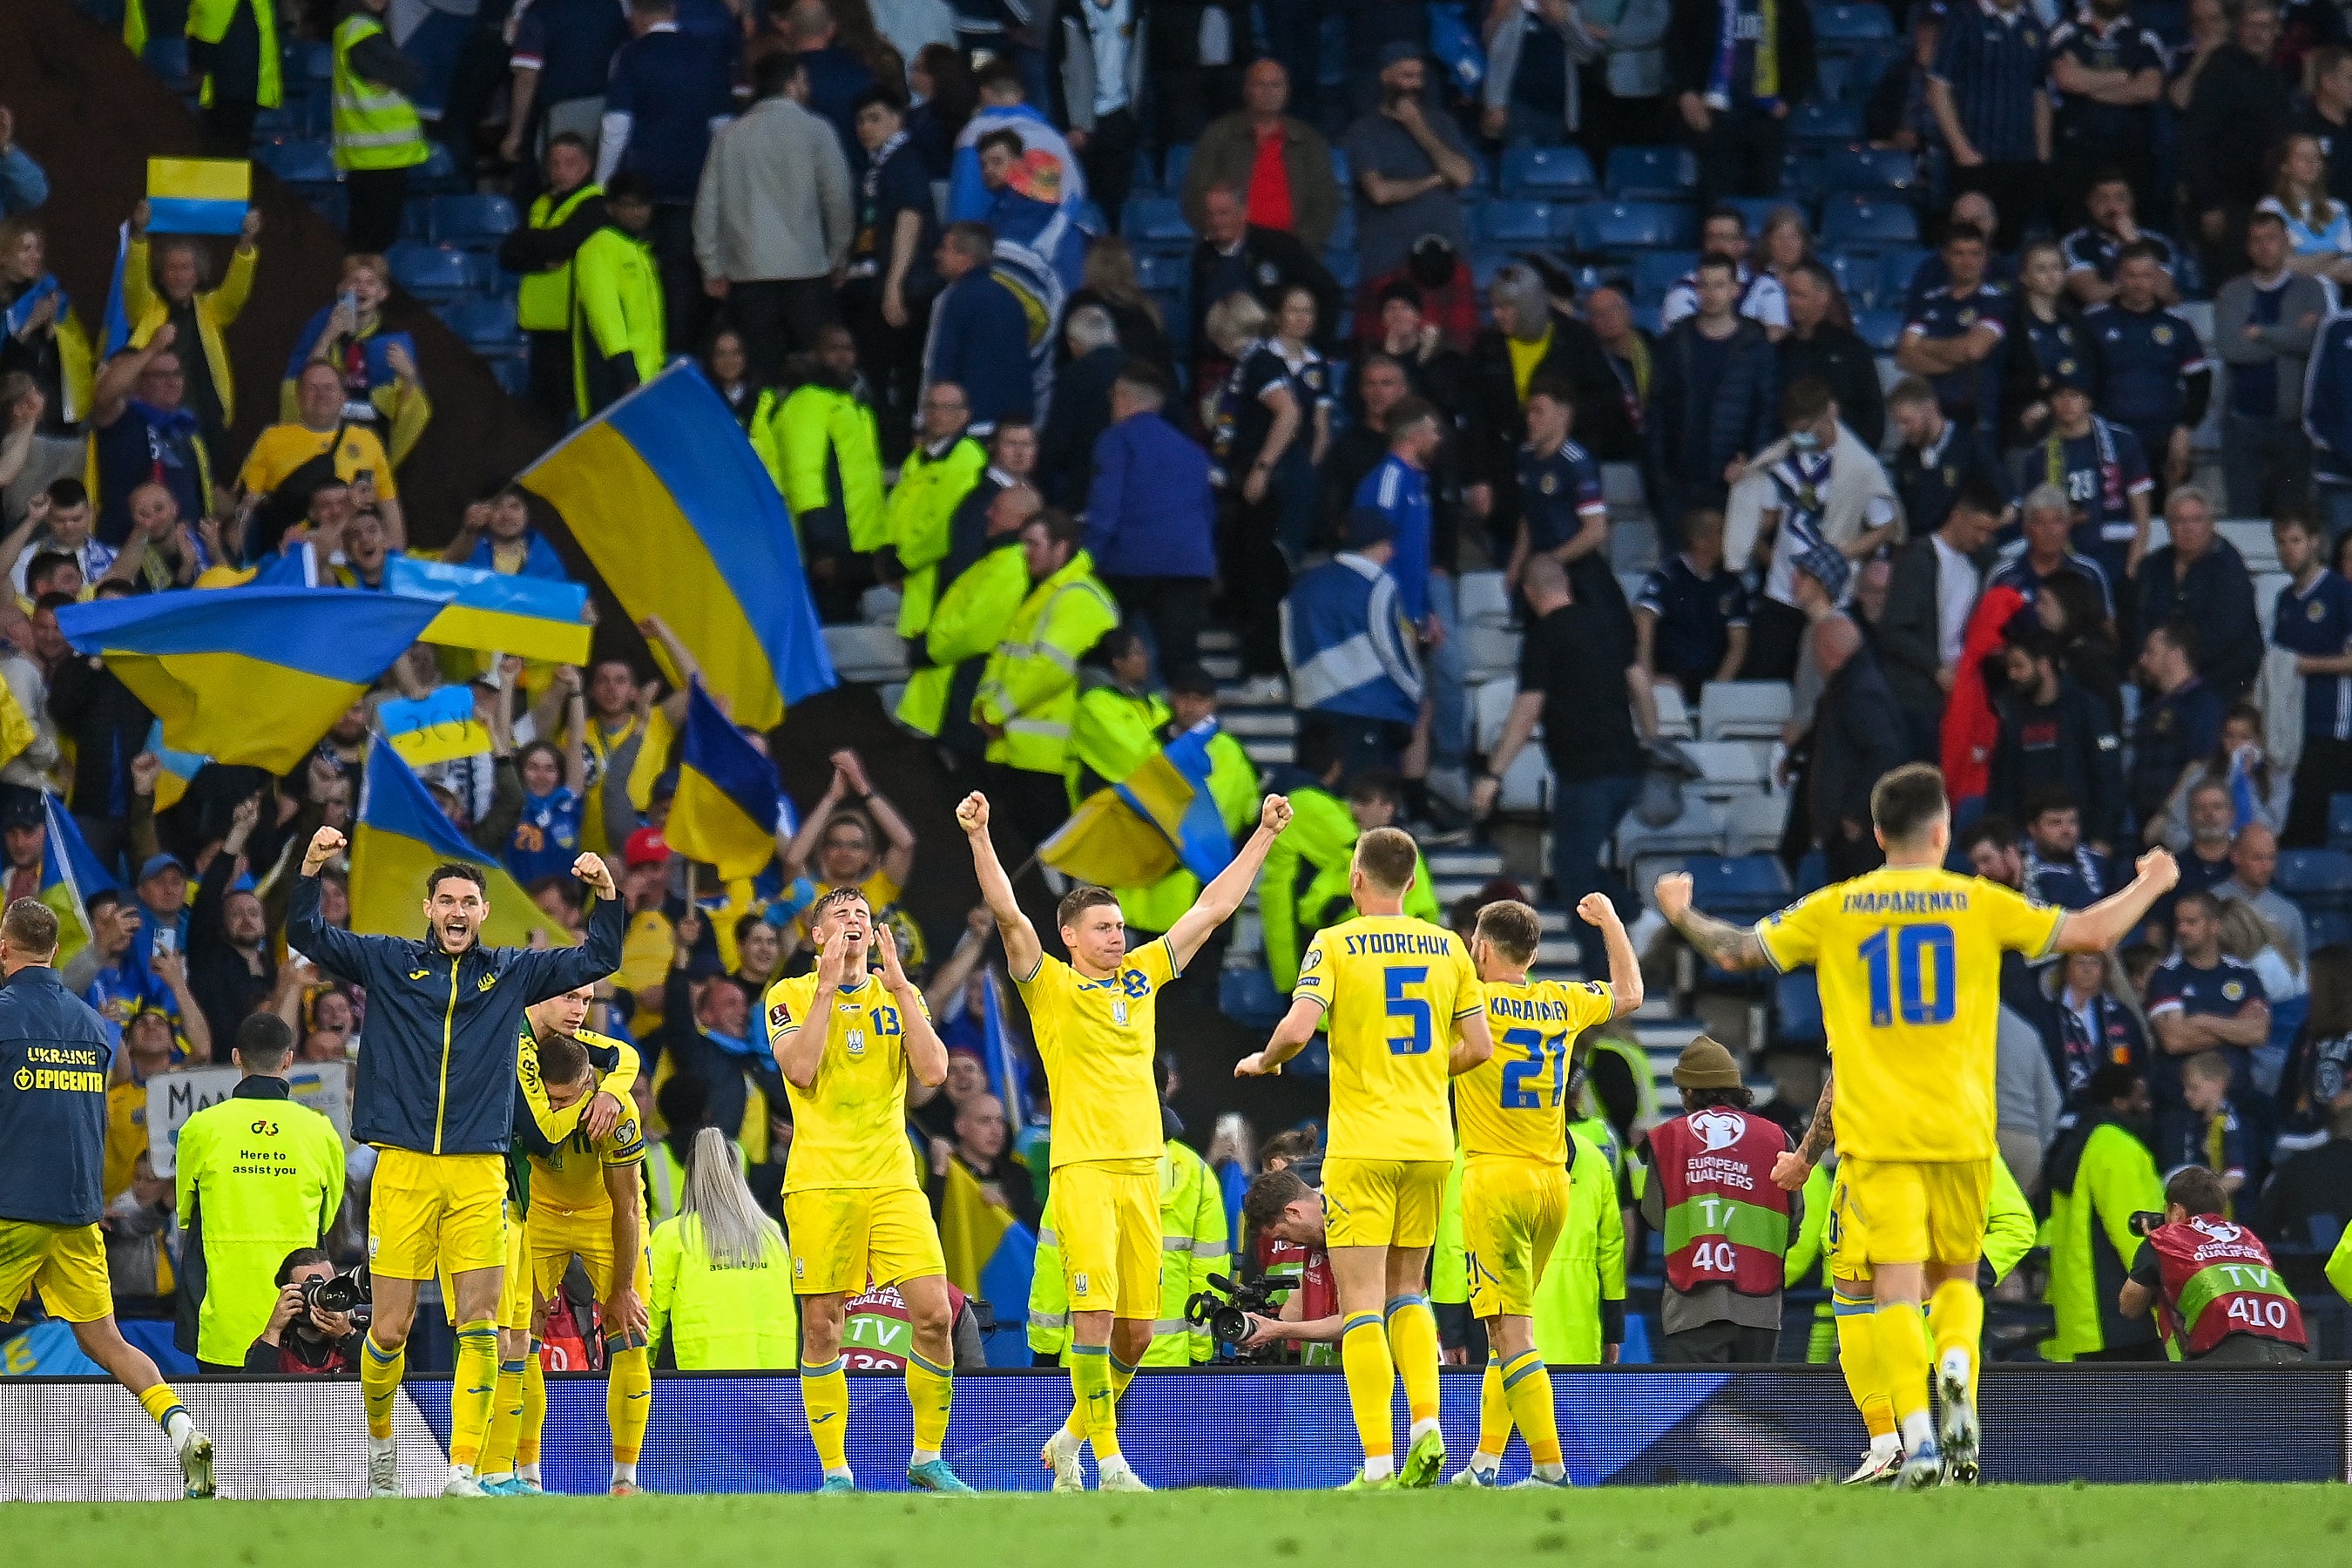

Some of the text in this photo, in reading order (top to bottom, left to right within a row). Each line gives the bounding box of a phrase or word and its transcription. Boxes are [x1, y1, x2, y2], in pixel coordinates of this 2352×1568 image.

[1344, 933, 1450, 956] SYDORCHUK
[1859, 923, 1957, 1027] 10
[869, 1005, 901, 1036] 13
[1383, 966, 1431, 1056] 5
[27, 1047, 97, 1065] UKRAINE
[1501, 1027, 1568, 1109] 21
[251, 1120, 280, 1137] G4S
[240, 1150, 287, 1160] Here to
[233, 1166, 297, 1177] assist you
[2220, 1266, 2268, 1288] TV
[2227, 1297, 2288, 1329] 410
[851, 1318, 902, 1347] TV
